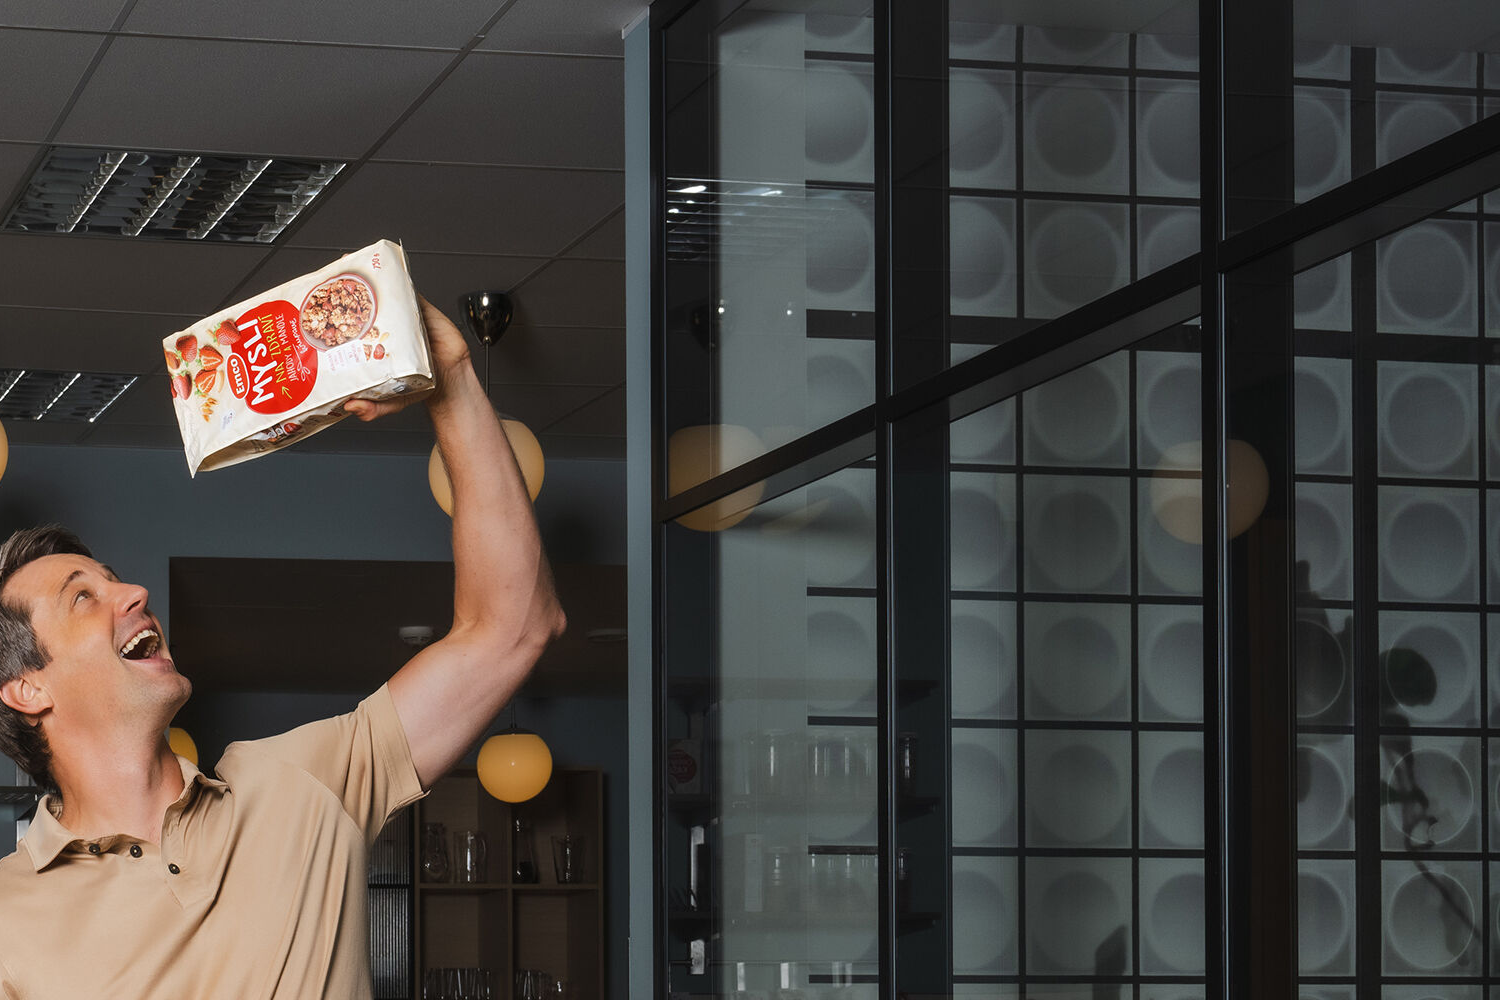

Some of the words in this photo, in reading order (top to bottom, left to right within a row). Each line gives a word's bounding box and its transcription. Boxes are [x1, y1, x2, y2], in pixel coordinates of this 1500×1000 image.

[261, 313, 283, 361] ZDRAVÍ
[275, 313, 288, 345] MANDLE
[229, 359, 245, 395] Emco
[237, 318, 277, 406] MYSLI
[274, 364, 288, 383] NA
[283, 351, 300, 381] JAHODY
